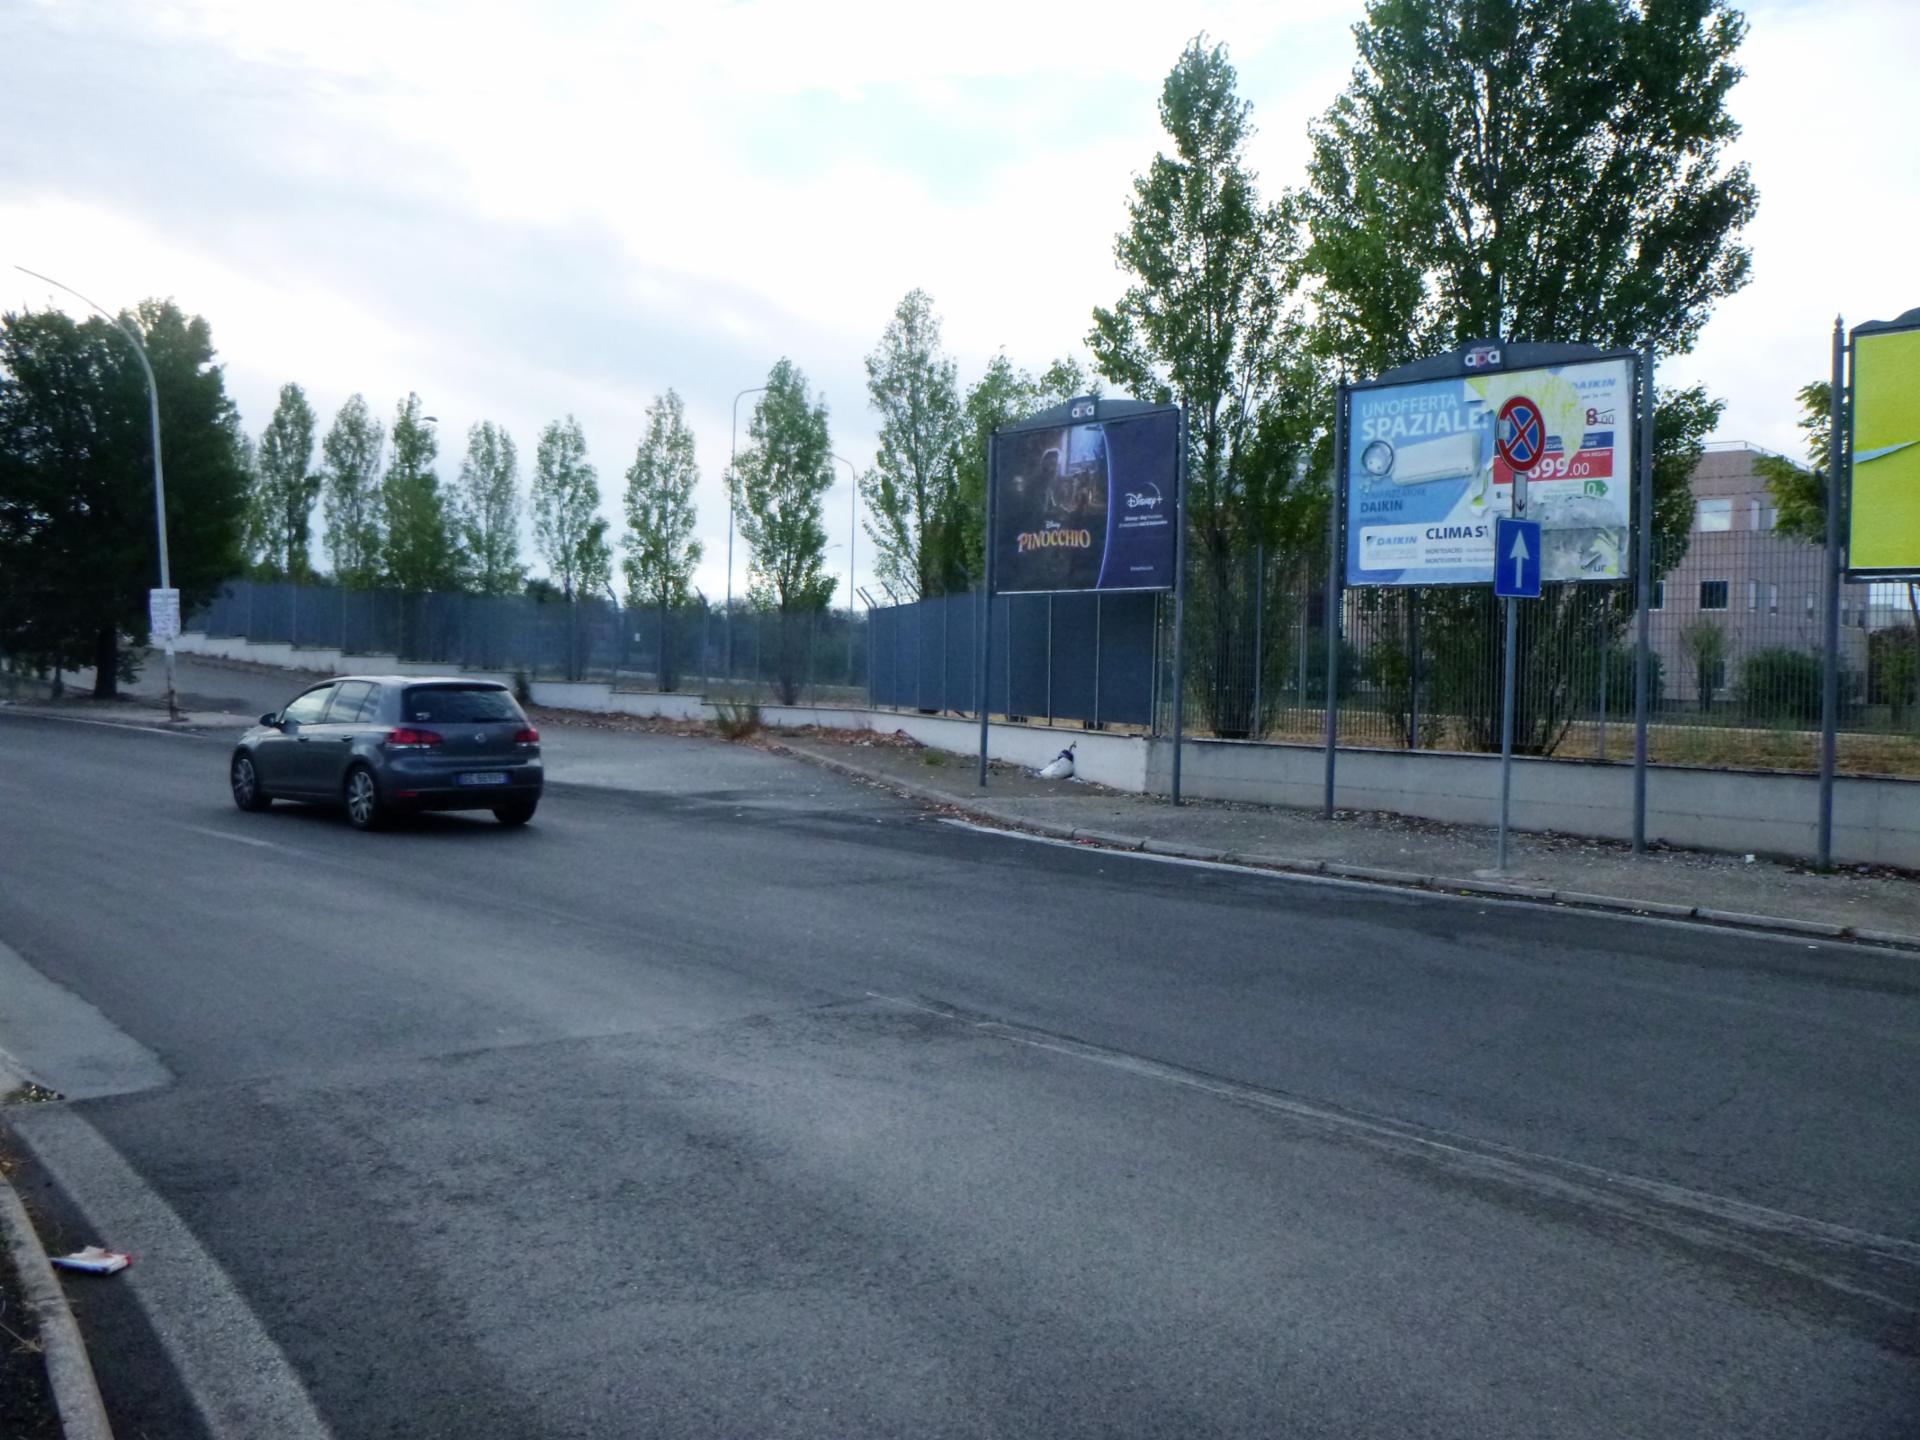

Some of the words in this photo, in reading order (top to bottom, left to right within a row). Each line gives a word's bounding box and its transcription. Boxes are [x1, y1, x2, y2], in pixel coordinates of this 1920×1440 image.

[1360, 499, 1403, 513] DAIKIN
[1426, 526, 1473, 540] CLIMA
[1017, 529, 1092, 553] PINOCCHIO
[1376, 535, 1418, 546] DAIKIN
